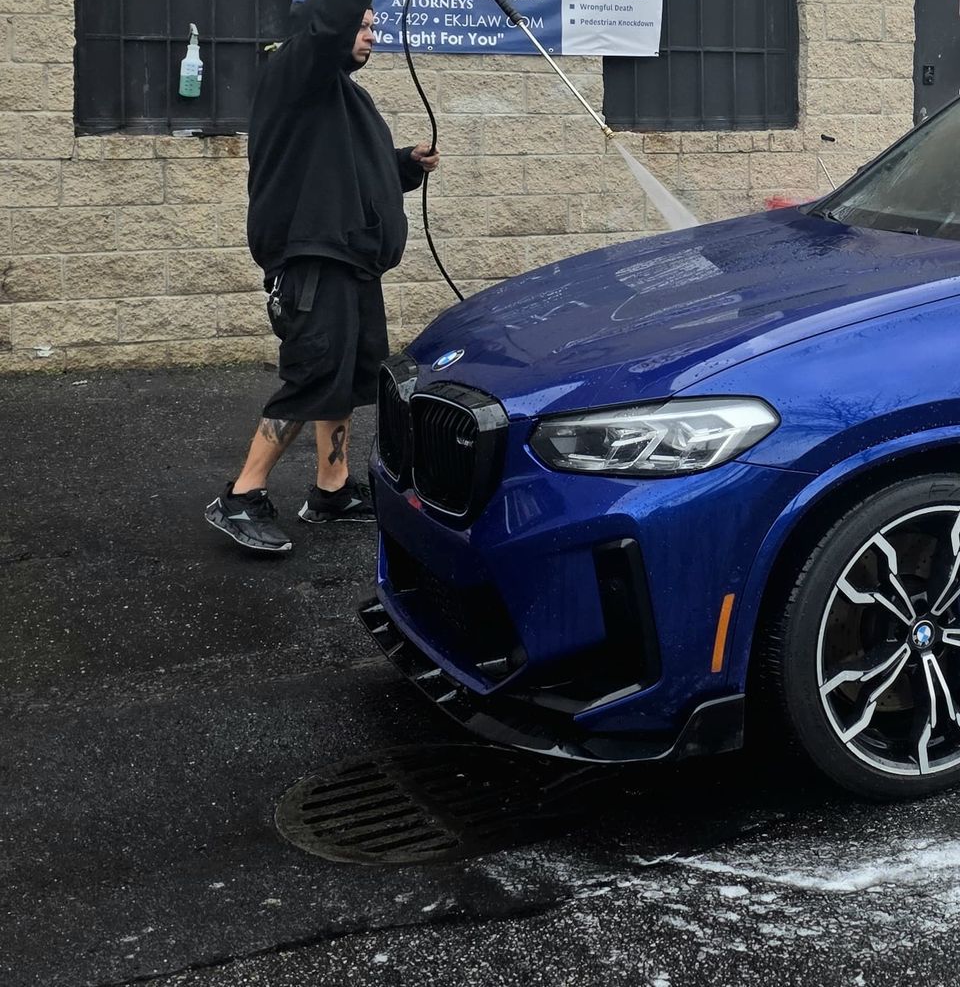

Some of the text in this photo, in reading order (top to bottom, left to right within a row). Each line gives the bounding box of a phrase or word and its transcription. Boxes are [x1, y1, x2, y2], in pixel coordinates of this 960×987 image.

[580, 3, 634, 12] Wrongful Death
[580, 18, 617, 26] Pedestrian
[440, 32, 463, 45] For
